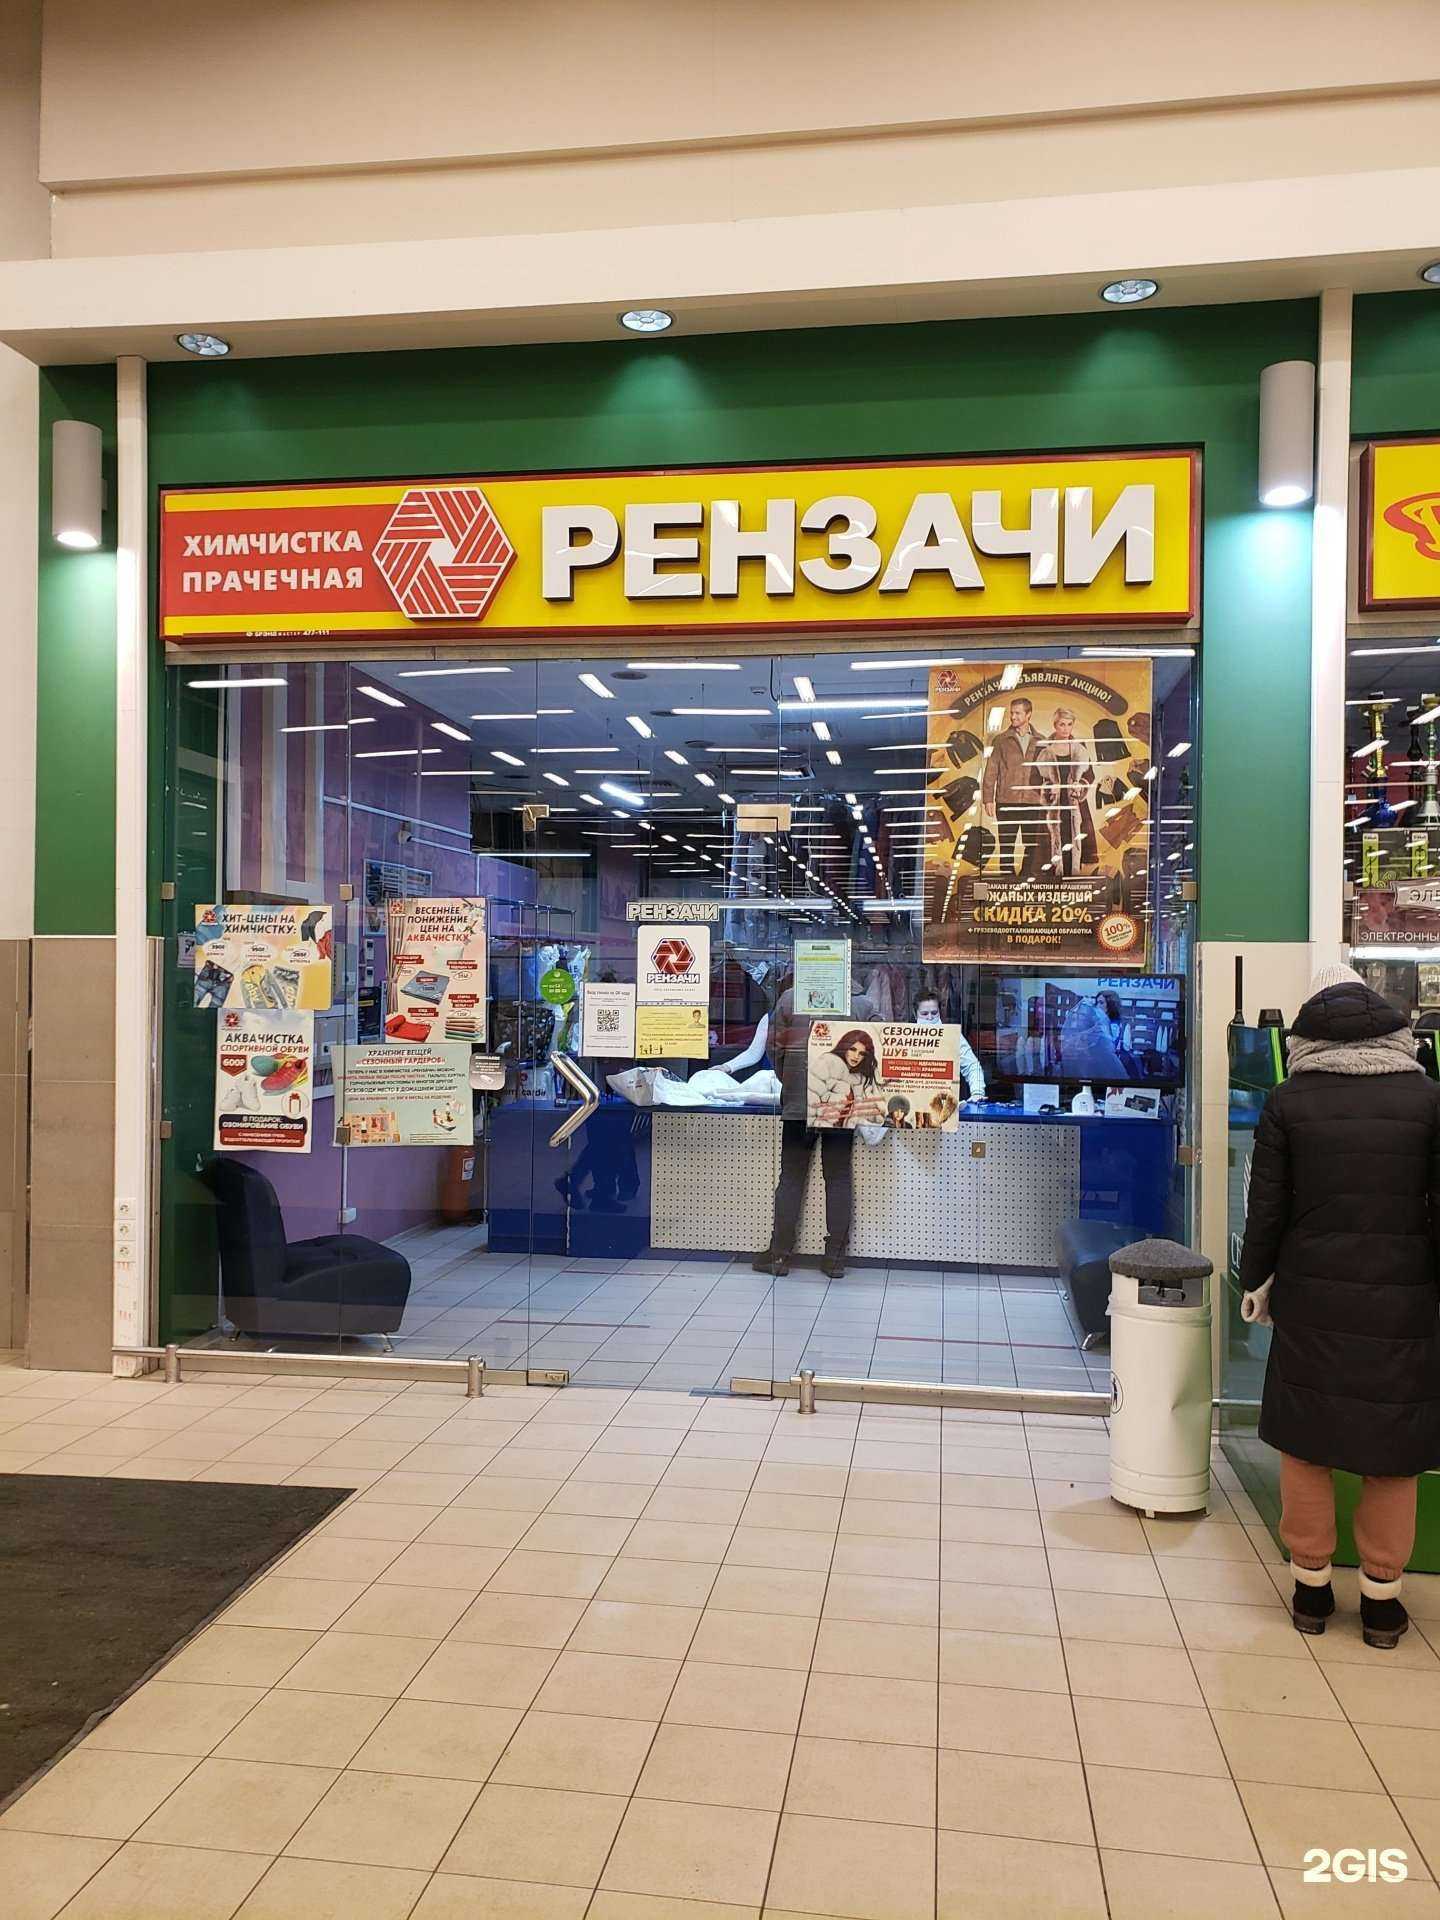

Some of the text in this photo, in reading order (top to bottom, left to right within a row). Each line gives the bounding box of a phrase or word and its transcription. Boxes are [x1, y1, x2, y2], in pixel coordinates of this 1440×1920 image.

[183, 530, 363, 557] ХИМЧИСТКА
[542, 484, 1155, 601] РЕНЗАЧИ
[182, 567, 363, 593] ПРАЧЕЧНАЯ
[1013, 672, 1071, 686] БЪЯВЛЯЕТ
[1071, 679, 1112, 704] АКЦИЮ!
[986, 890, 1093, 904] ЖАНЫХ ИЗДЕЛИЙ
[415, 906, 460, 915] ВЕСЕННЕЕ
[627, 902, 720, 921] РЕНЗАЧИ
[973, 906, 1093, 925] СКИДКА 20%
[222, 914, 296, 925] ХИТ-ЦЕНЫ НА
[407, 915, 469, 924] ПОНИЖЕНИЕ
[224, 924, 297, 936] ХИМЧИСТКУ:
[420, 925, 455, 934] ЦЕН НА
[1058, 928, 1093, 936] ОБРАБОТКА
[1015, 935, 1061, 944] ПОДАРОК!
[1360, 931, 1440, 942] ЭЛЕКТРОННЫ
[647, 973, 701, 984] РЕНЗАЧИ
[1097, 977, 1175, 990] РЕНЗАЧИ
[882, 1026, 945, 1037] СЕЗОННОЕ
[225, 1033, 304, 1044] АКВАЧИСТКА
[882, 1037, 941, 1048] ХРАНЕНИЕ
[220, 1044, 309, 1053] СПОРТИВНОЙ ОБУВИ
[368, 1048, 432, 1057] ХРАНЕНИЕ ВЕЩЕЙ
[882, 1048, 908, 1057] ШУБ
